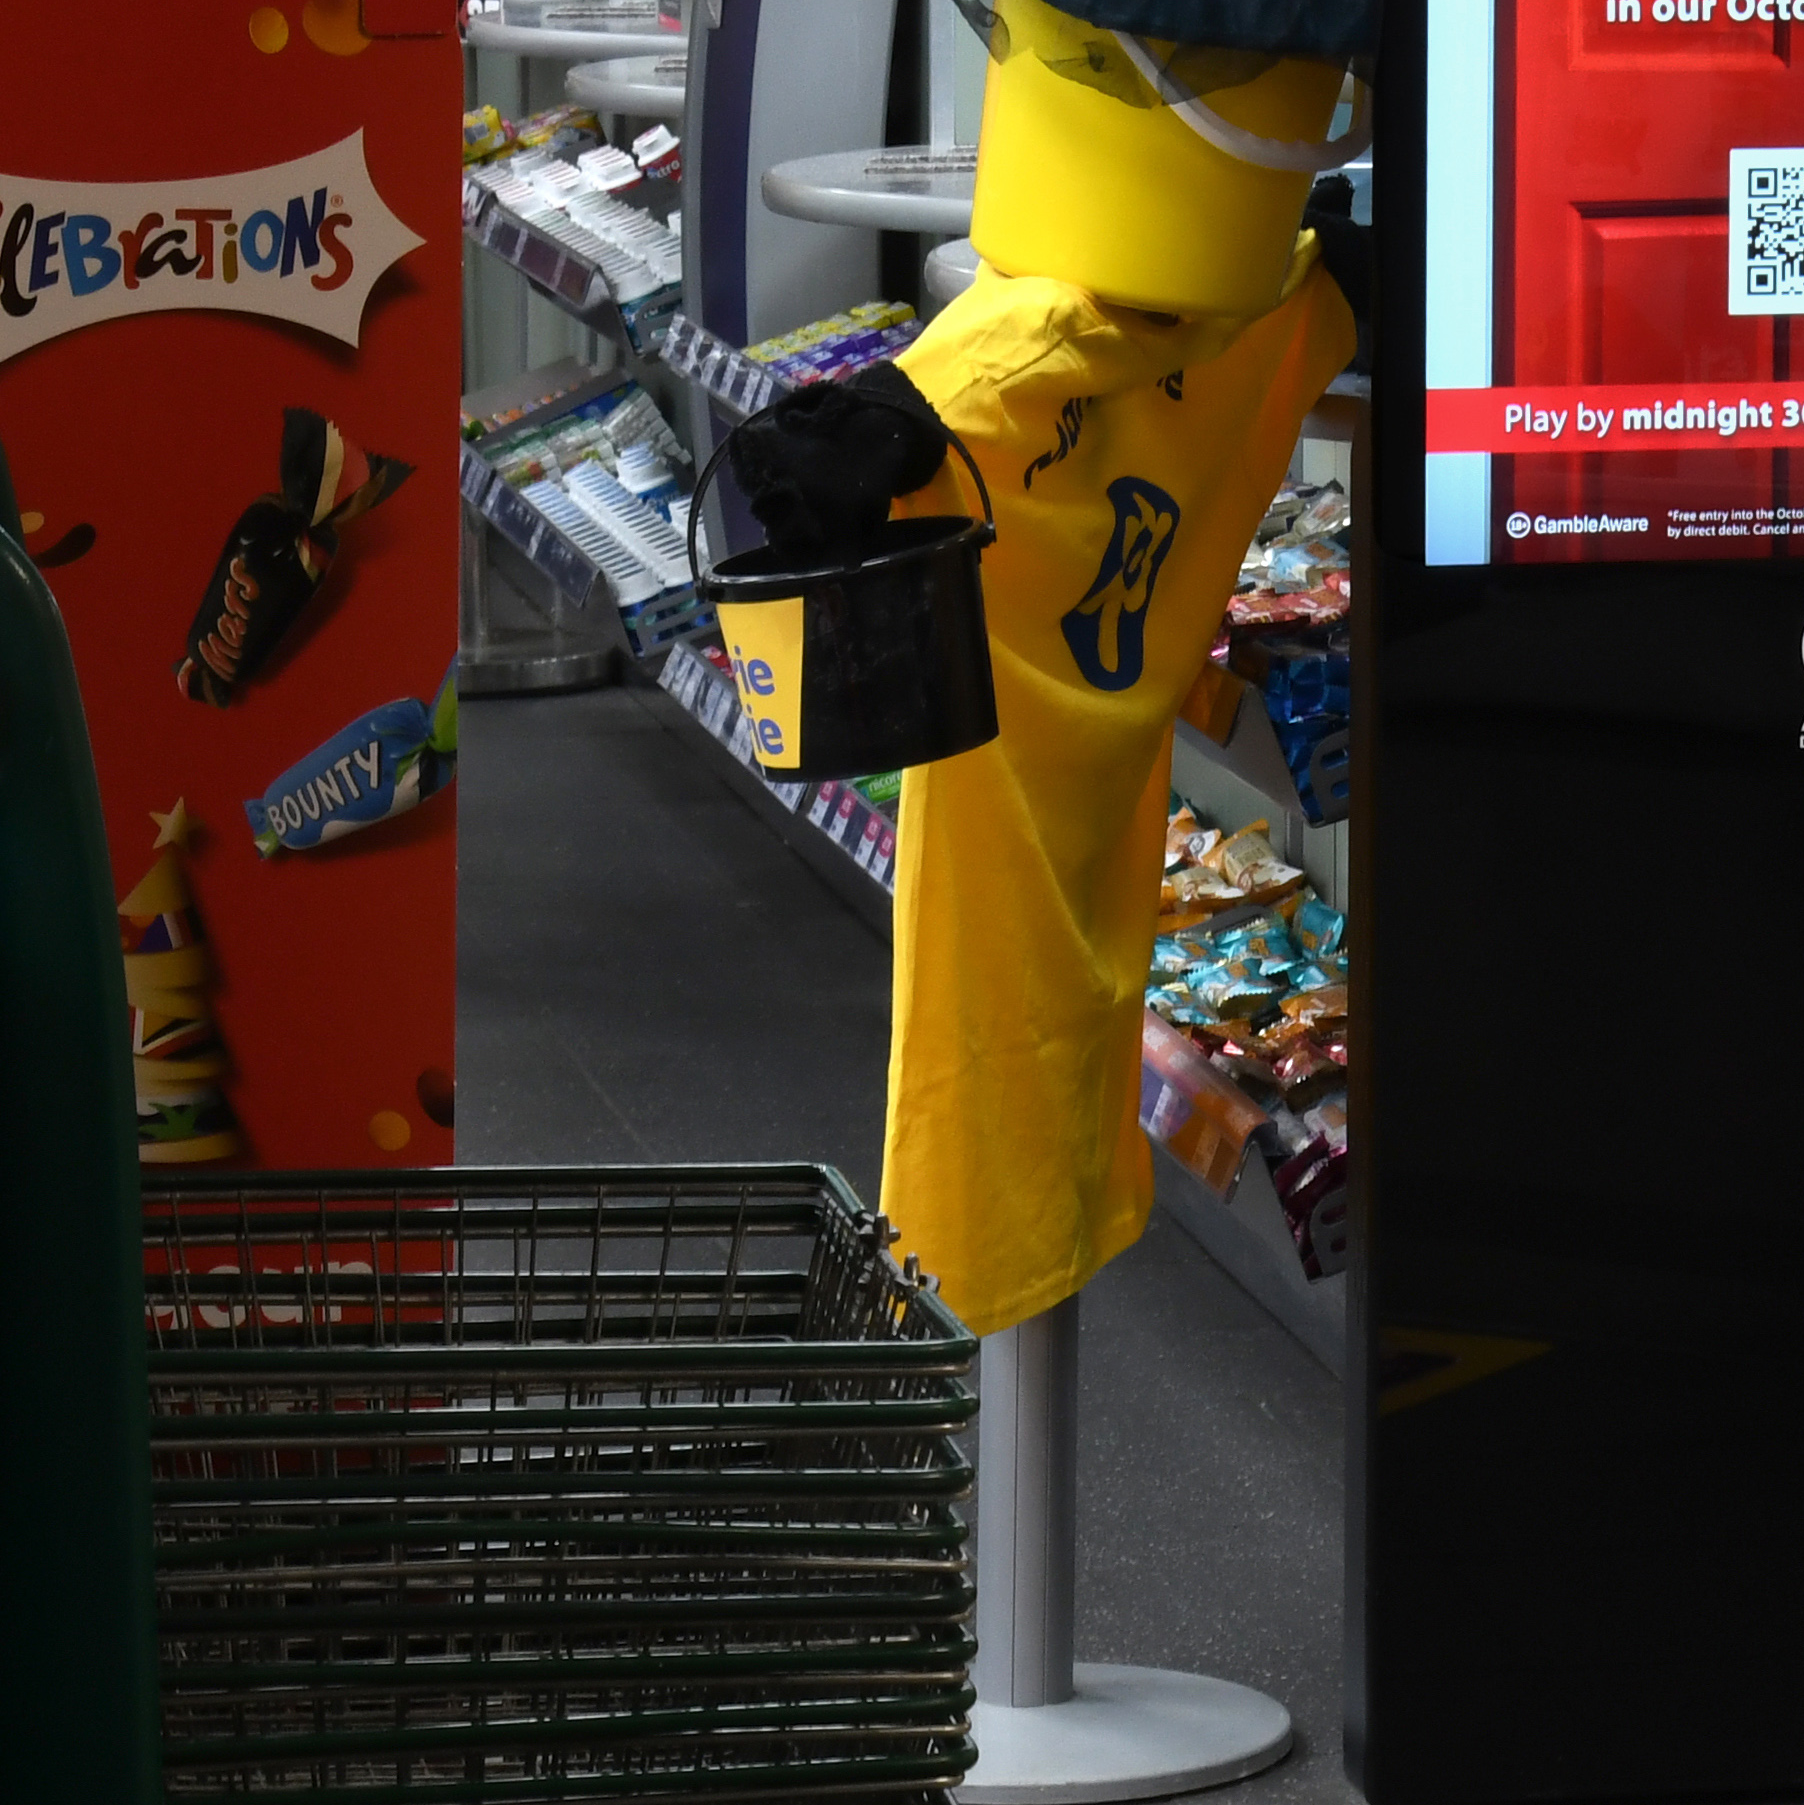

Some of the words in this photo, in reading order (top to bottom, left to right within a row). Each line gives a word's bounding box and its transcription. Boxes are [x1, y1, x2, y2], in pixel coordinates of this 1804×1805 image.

[1504, 404, 1567, 440] Play
[1575, 402, 1614, 439] by
[1623, 399, 1773, 437] midnight
[1534, 513, 1649, 536] GambleAware
[1667, 525, 1681, 539] by
[1683, 523, 1716, 536] direct
[1718, 522, 1750, 536] debit.
[1753, 521, 1790, 535] Cancel
[1699, 510, 1729, 526] entry
[1731, 508, 1753, 521] into
[1756, 507, 1774, 520] the
[199, 559, 260, 683] Mars
[267, 739, 384, 838] BOUNTY
